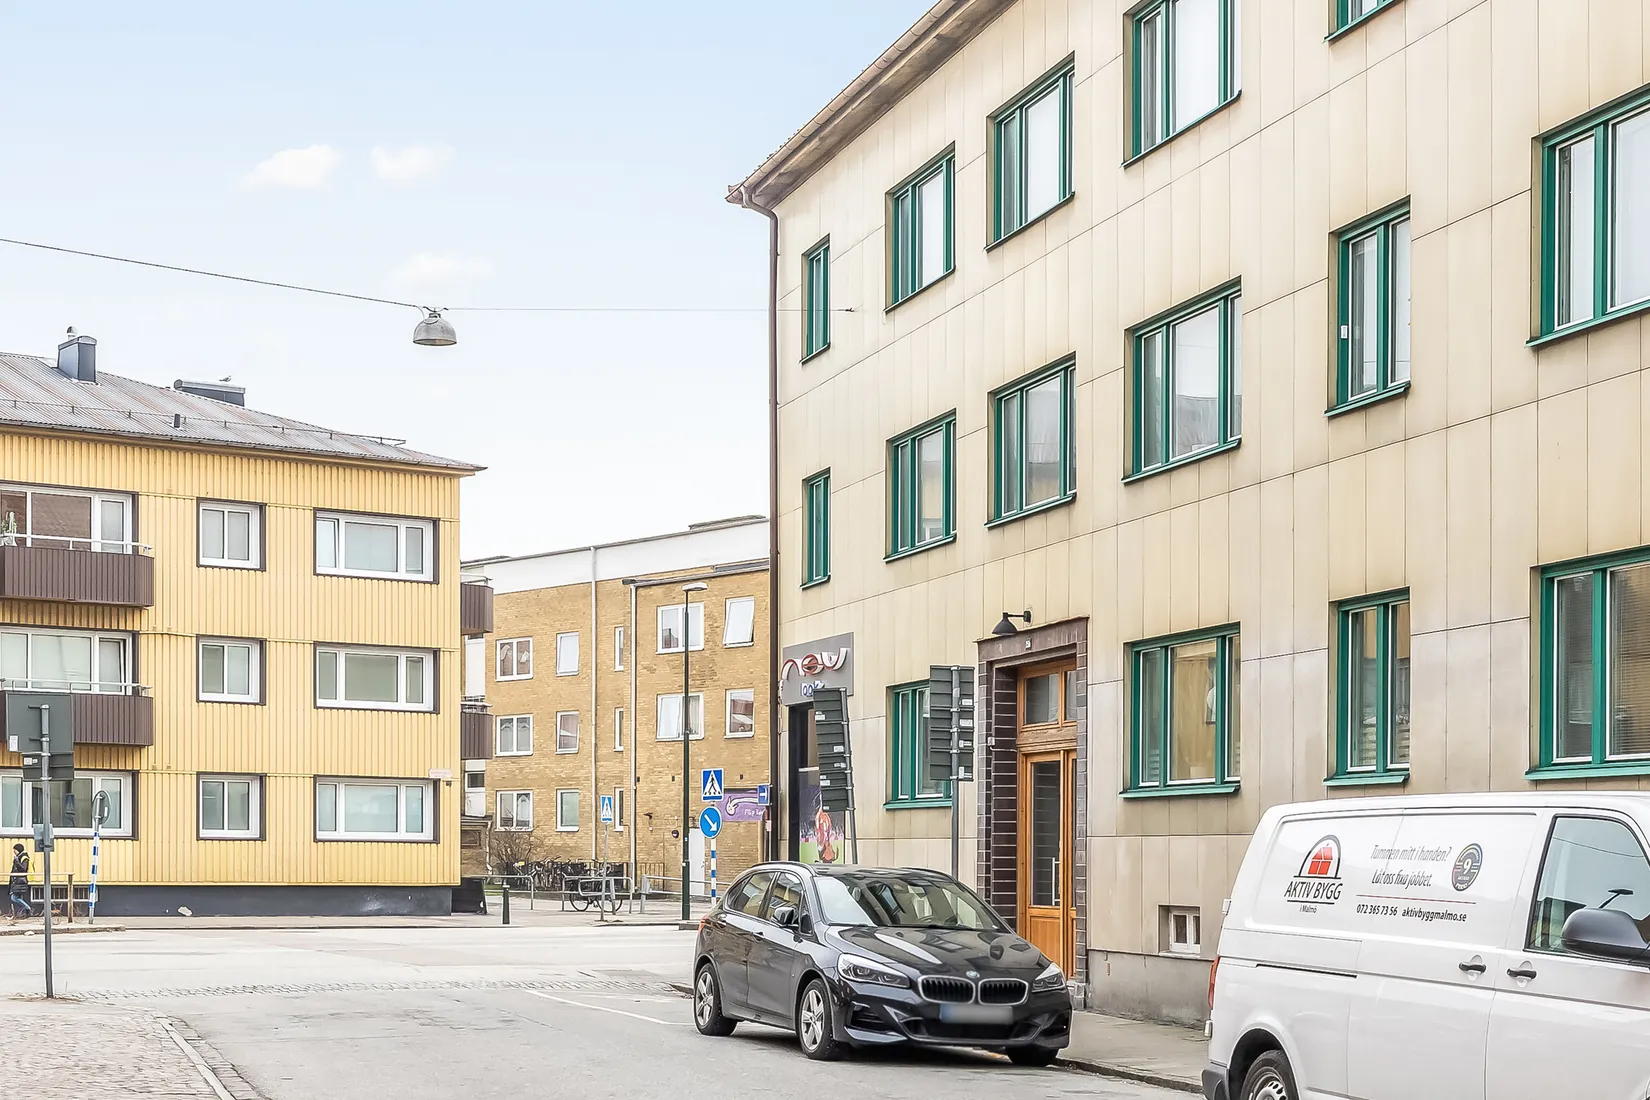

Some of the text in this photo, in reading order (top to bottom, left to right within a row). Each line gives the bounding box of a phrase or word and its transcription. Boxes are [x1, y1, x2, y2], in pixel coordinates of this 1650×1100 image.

[1370, 845, 1400, 860] Tummen
[1399, 846, 1416, 860] mitt
[1418, 846, 1452, 861] handen?
[1463, 858, 1472, 875] 9
[1371, 868, 1432, 889] Låt oss fixa jobbet.
[1284, 881, 1343, 900] AKTIV BYGG
[1302, 905, 1317, 913] Malmö
[1356, 904, 1398, 916] 072 365 73 56
[1402, 907, 1467, 922] aktivbyggmalmo.se
